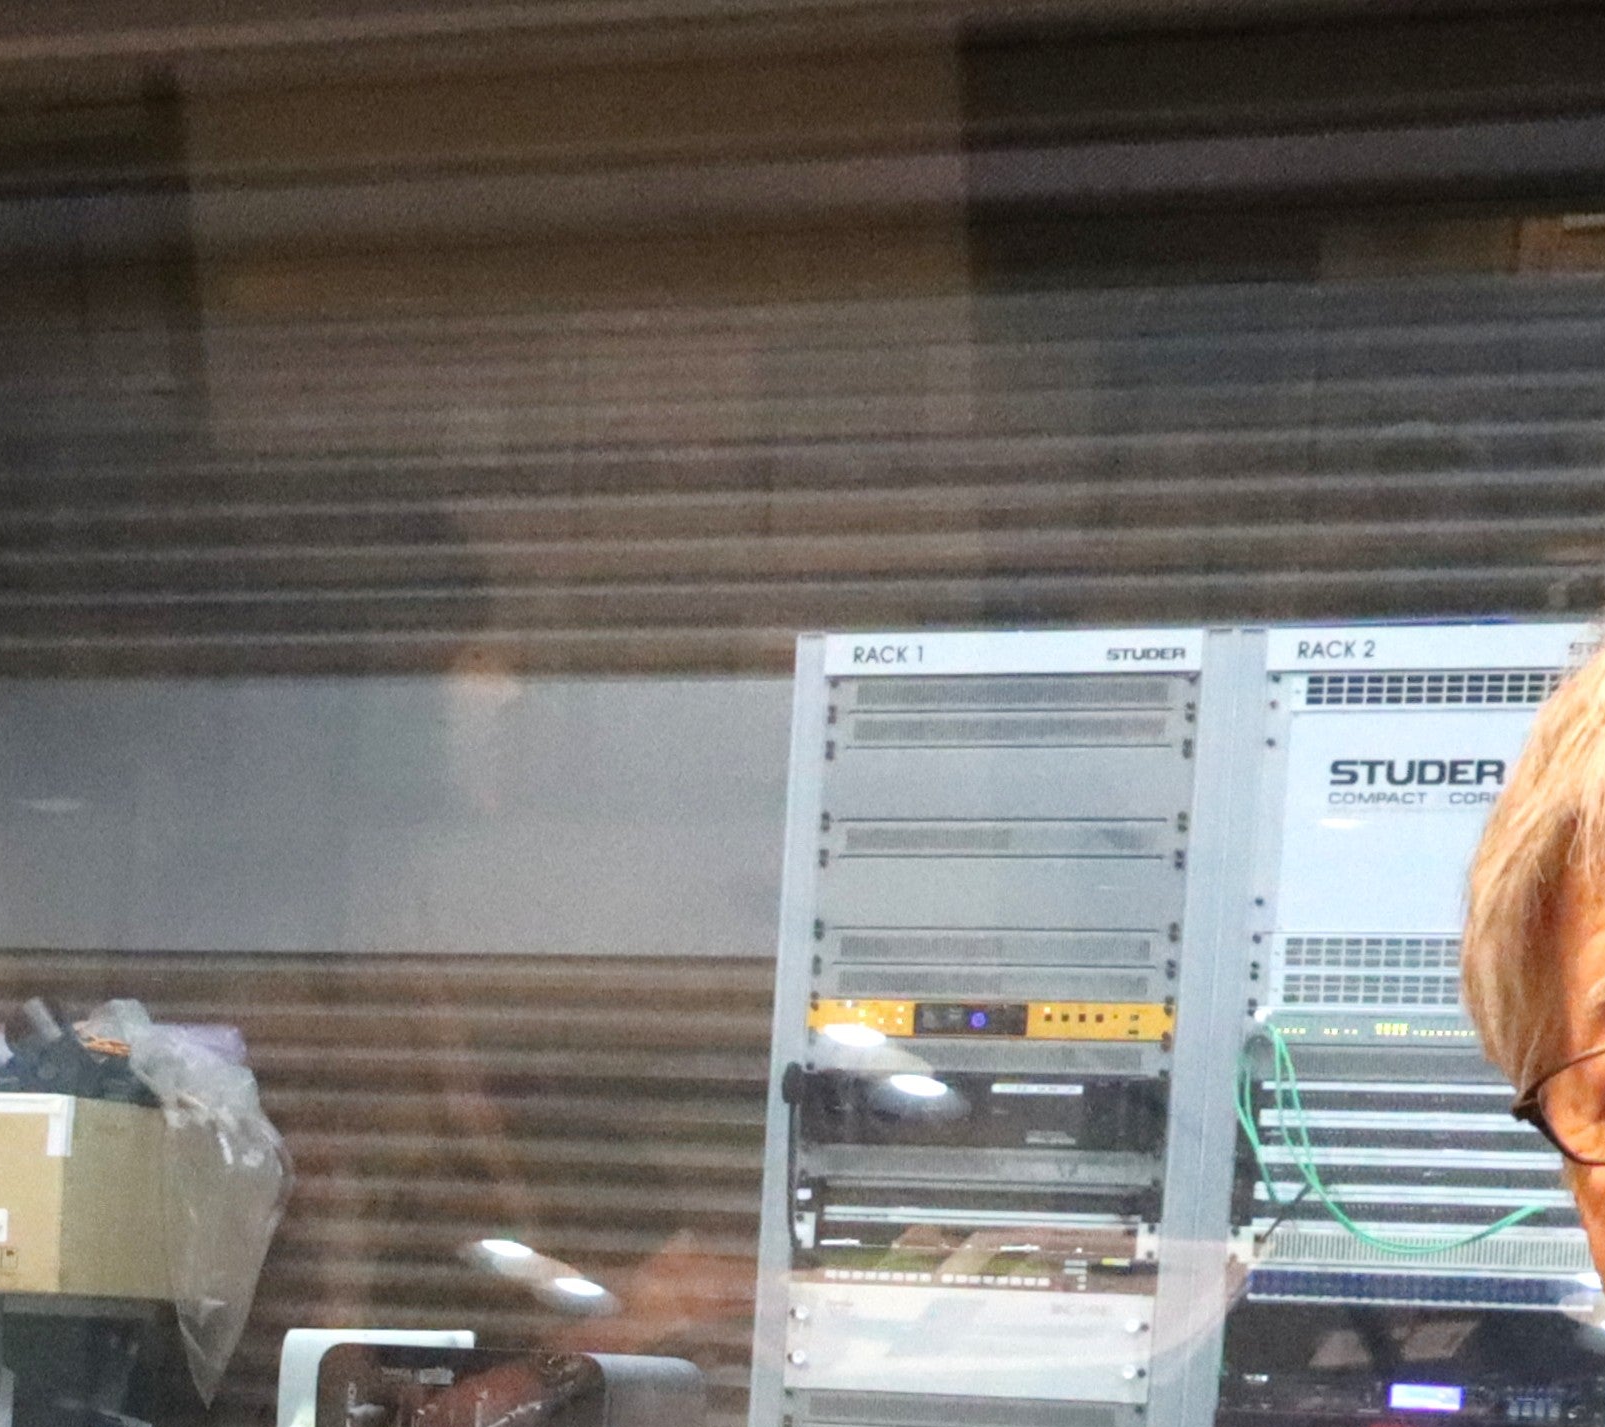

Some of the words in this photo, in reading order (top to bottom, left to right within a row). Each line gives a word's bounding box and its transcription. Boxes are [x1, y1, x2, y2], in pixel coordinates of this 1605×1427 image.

[852, 646, 909, 664] RACK
[916, 645, 924, 663] 1
[1105, 647, 1186, 662] STUDER
[1297, 640, 1357, 660] RACK
[1363, 640, 1376, 658] 2
[1329, 760, 1506, 786] STUDER
[1328, 792, 1428, 806] COMPACT
